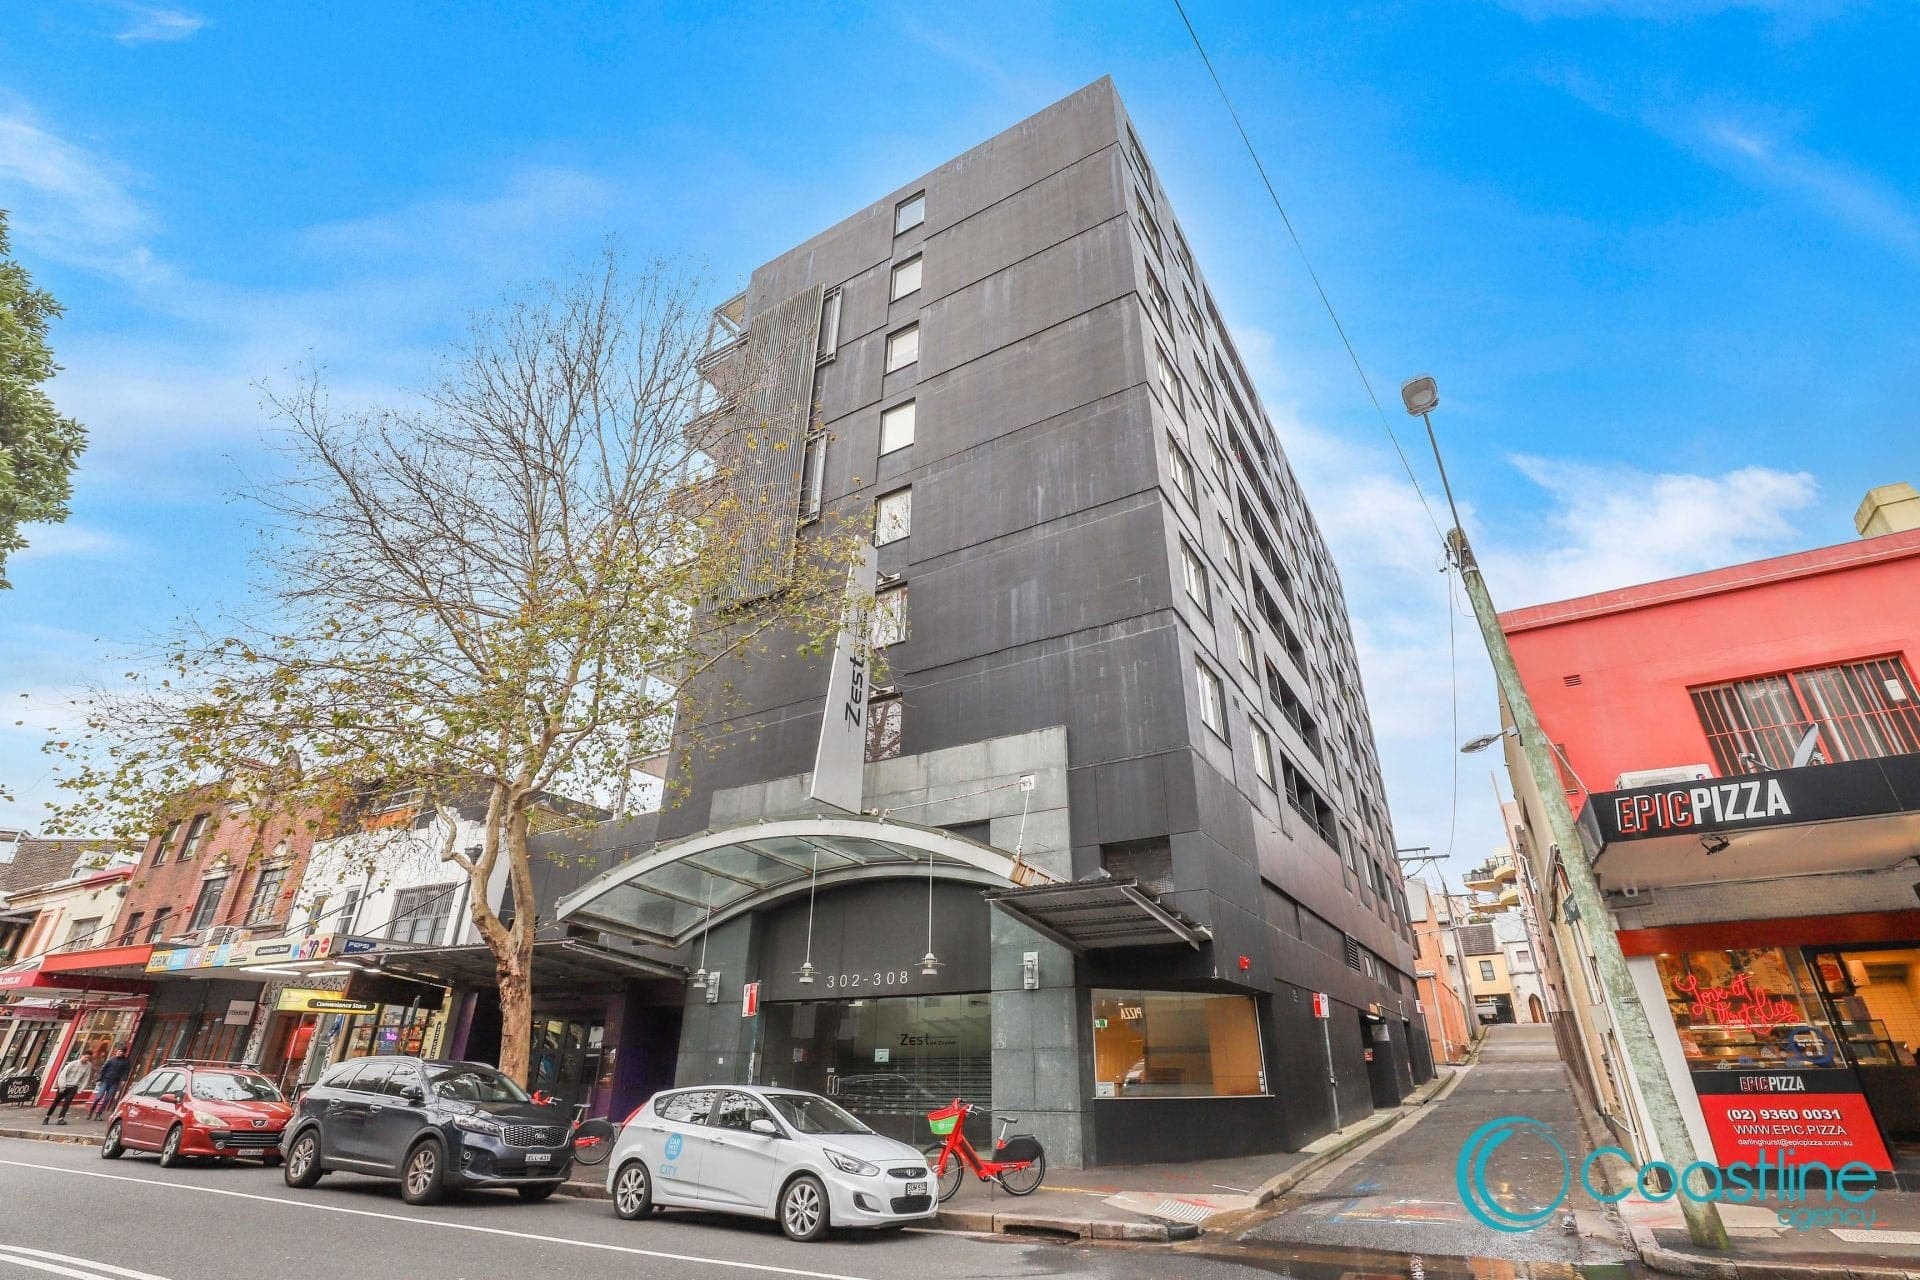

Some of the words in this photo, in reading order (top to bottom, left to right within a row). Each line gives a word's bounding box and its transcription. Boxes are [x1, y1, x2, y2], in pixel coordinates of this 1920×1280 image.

[826, 970, 909, 988] 302-308
[1727, 1108, 1758, 1123] (02)
[1759, 1108, 1799, 1120] 9360
[1802, 1108, 1841, 1120] 0031
[1733, 1124, 1848, 1136] WWW.EPIC.PIZZA
[659, 1163, 679, 1177] CITY
